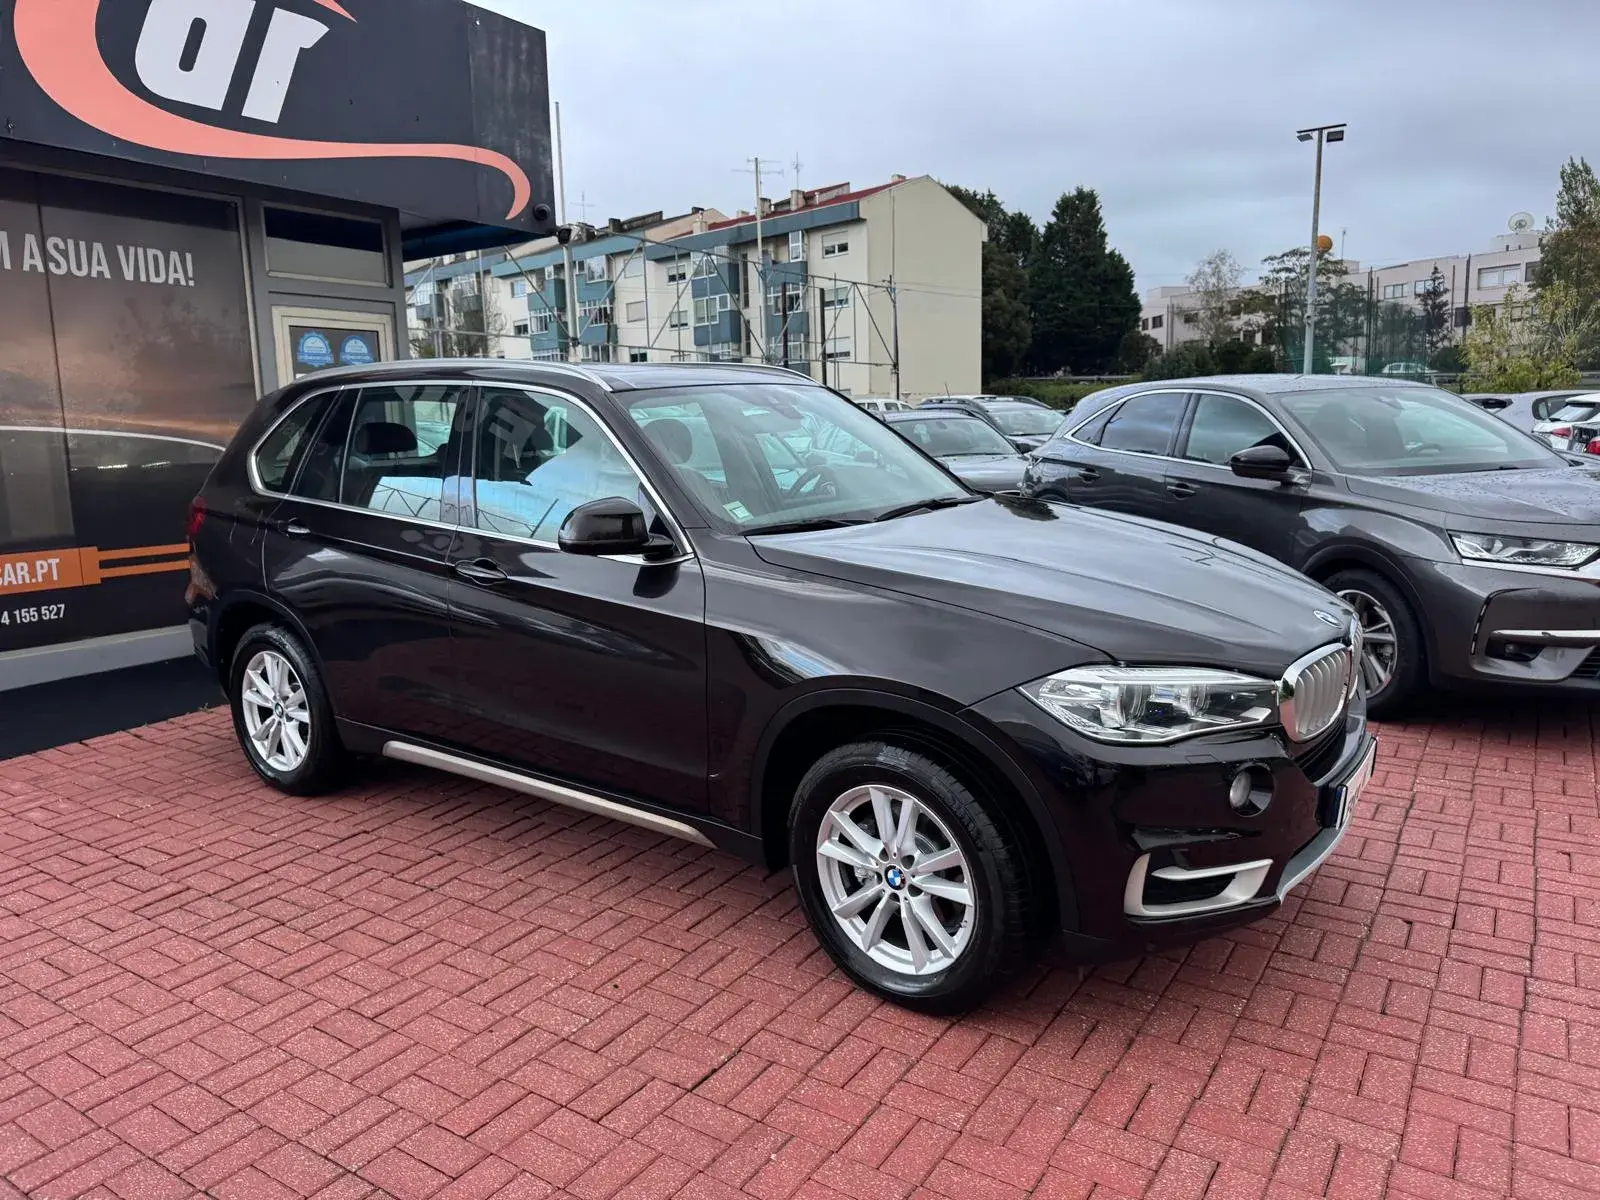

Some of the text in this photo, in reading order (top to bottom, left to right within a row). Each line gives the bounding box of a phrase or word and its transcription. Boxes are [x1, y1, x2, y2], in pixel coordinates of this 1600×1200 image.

[116, 244, 195, 287] VIDA!
[0, 558, 60, 586] AR.PT
[13, 606, 39, 624] 155
[41, 603, 65, 620] 527
